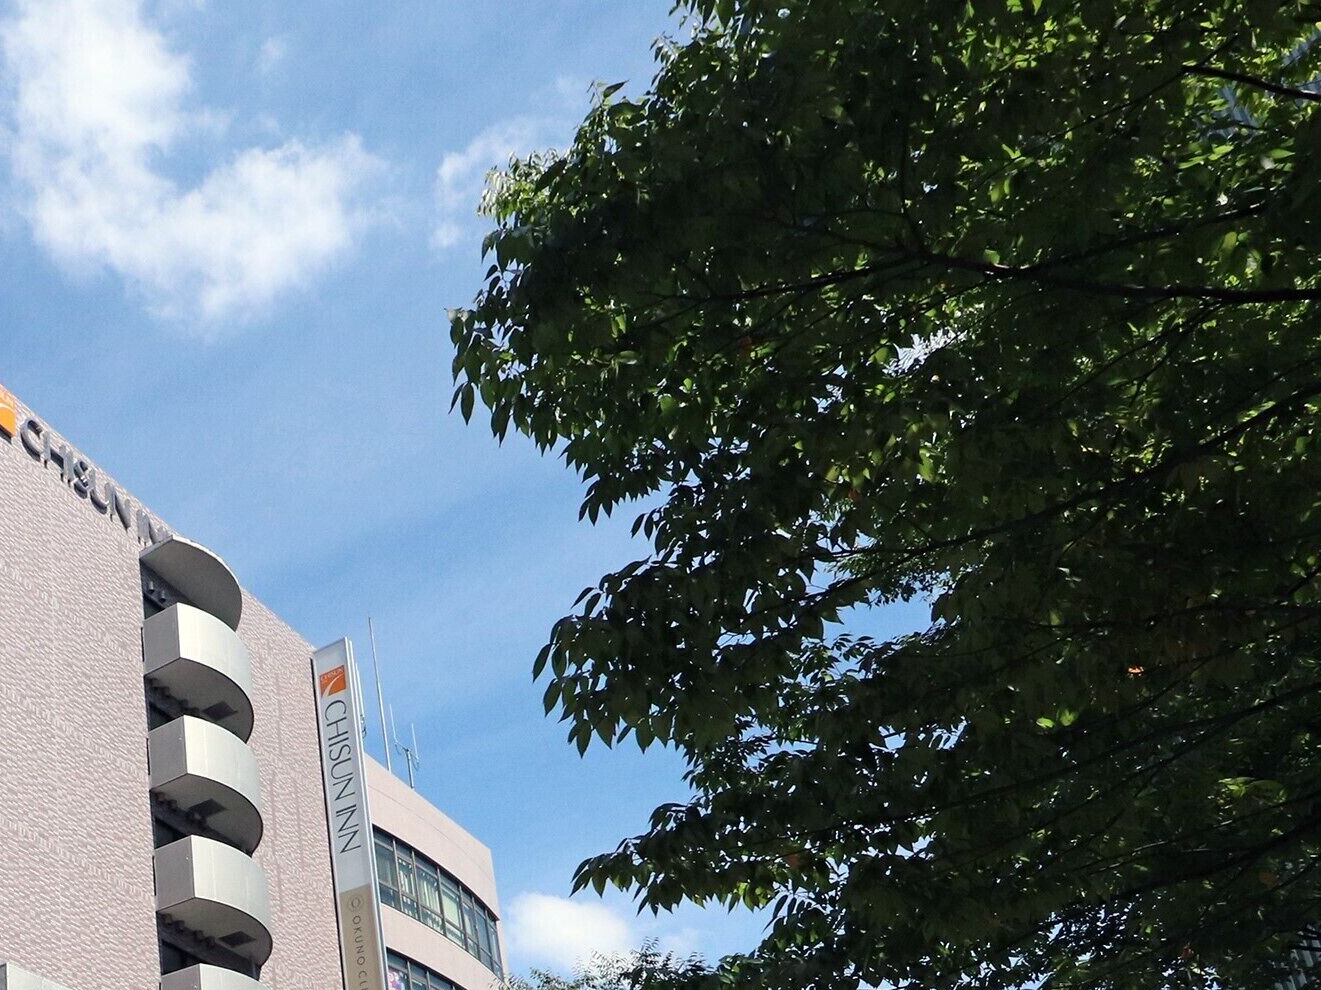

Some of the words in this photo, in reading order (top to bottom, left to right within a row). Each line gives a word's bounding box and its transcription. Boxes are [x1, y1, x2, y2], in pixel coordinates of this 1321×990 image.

[20, 417, 131, 529] CHISUN
[325, 700, 356, 801] CHISUN
[336, 804, 362, 854] INN
[352, 915, 367, 966] OKUNO
